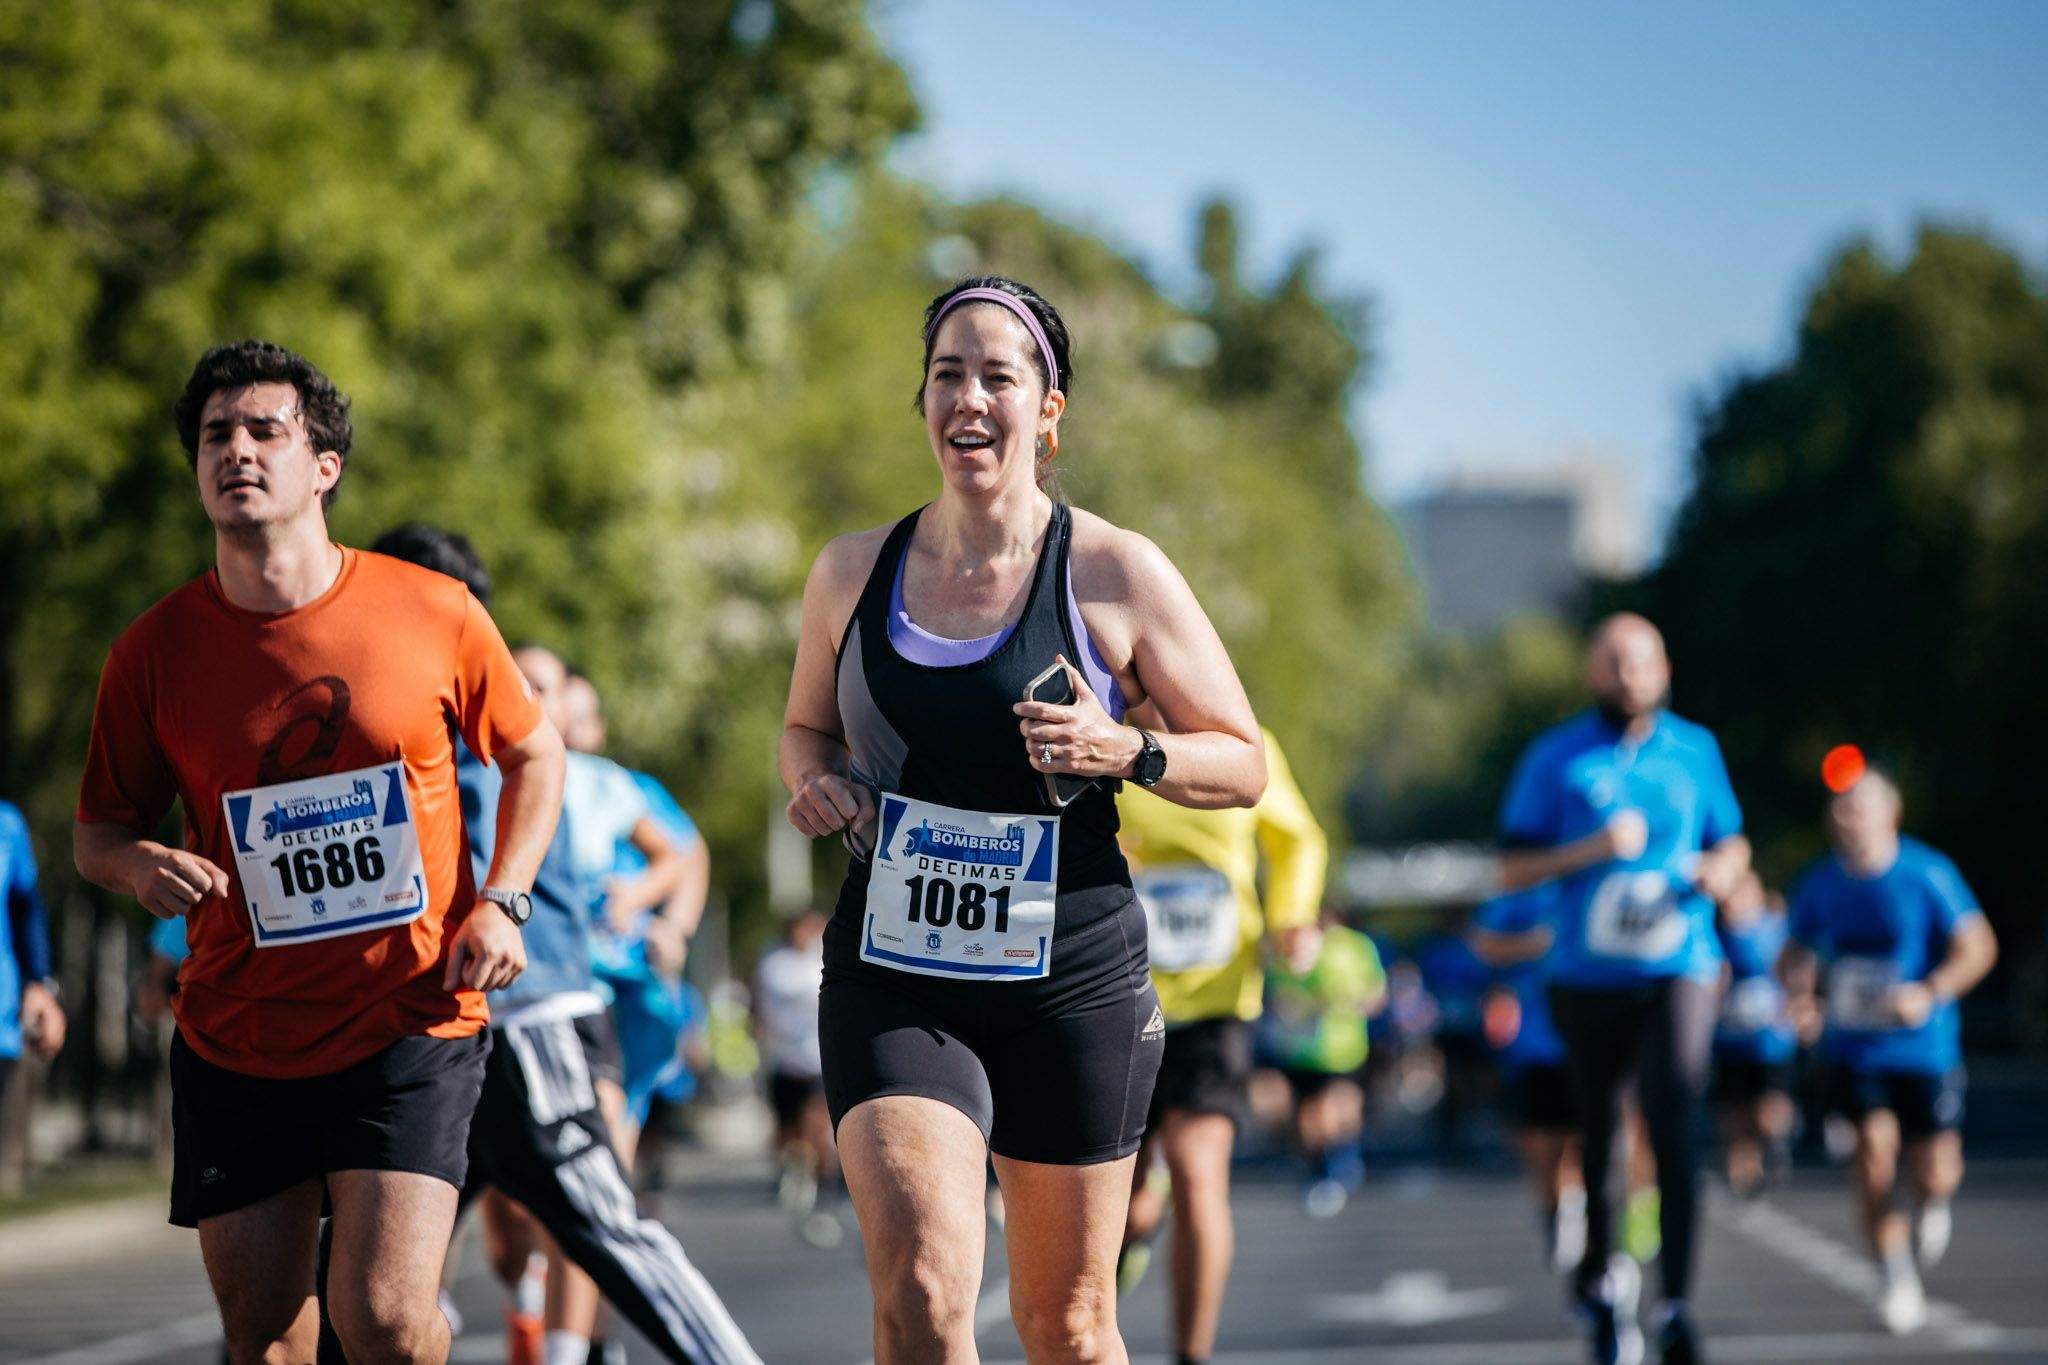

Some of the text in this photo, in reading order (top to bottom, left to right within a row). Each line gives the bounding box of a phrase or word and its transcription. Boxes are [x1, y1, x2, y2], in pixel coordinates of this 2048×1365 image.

[287, 791, 371, 819] BOMBEROS
[281, 819, 375, 847] DECIMAS
[932, 830, 1020, 851] BOMBEROS
[933, 822, 966, 834] CARRERA
[270, 836, 386, 898] 1686
[918, 856, 1016, 881] DECIMAS
[963, 848, 1020, 866] de MADRID
[904, 874, 1011, 933] 1081
